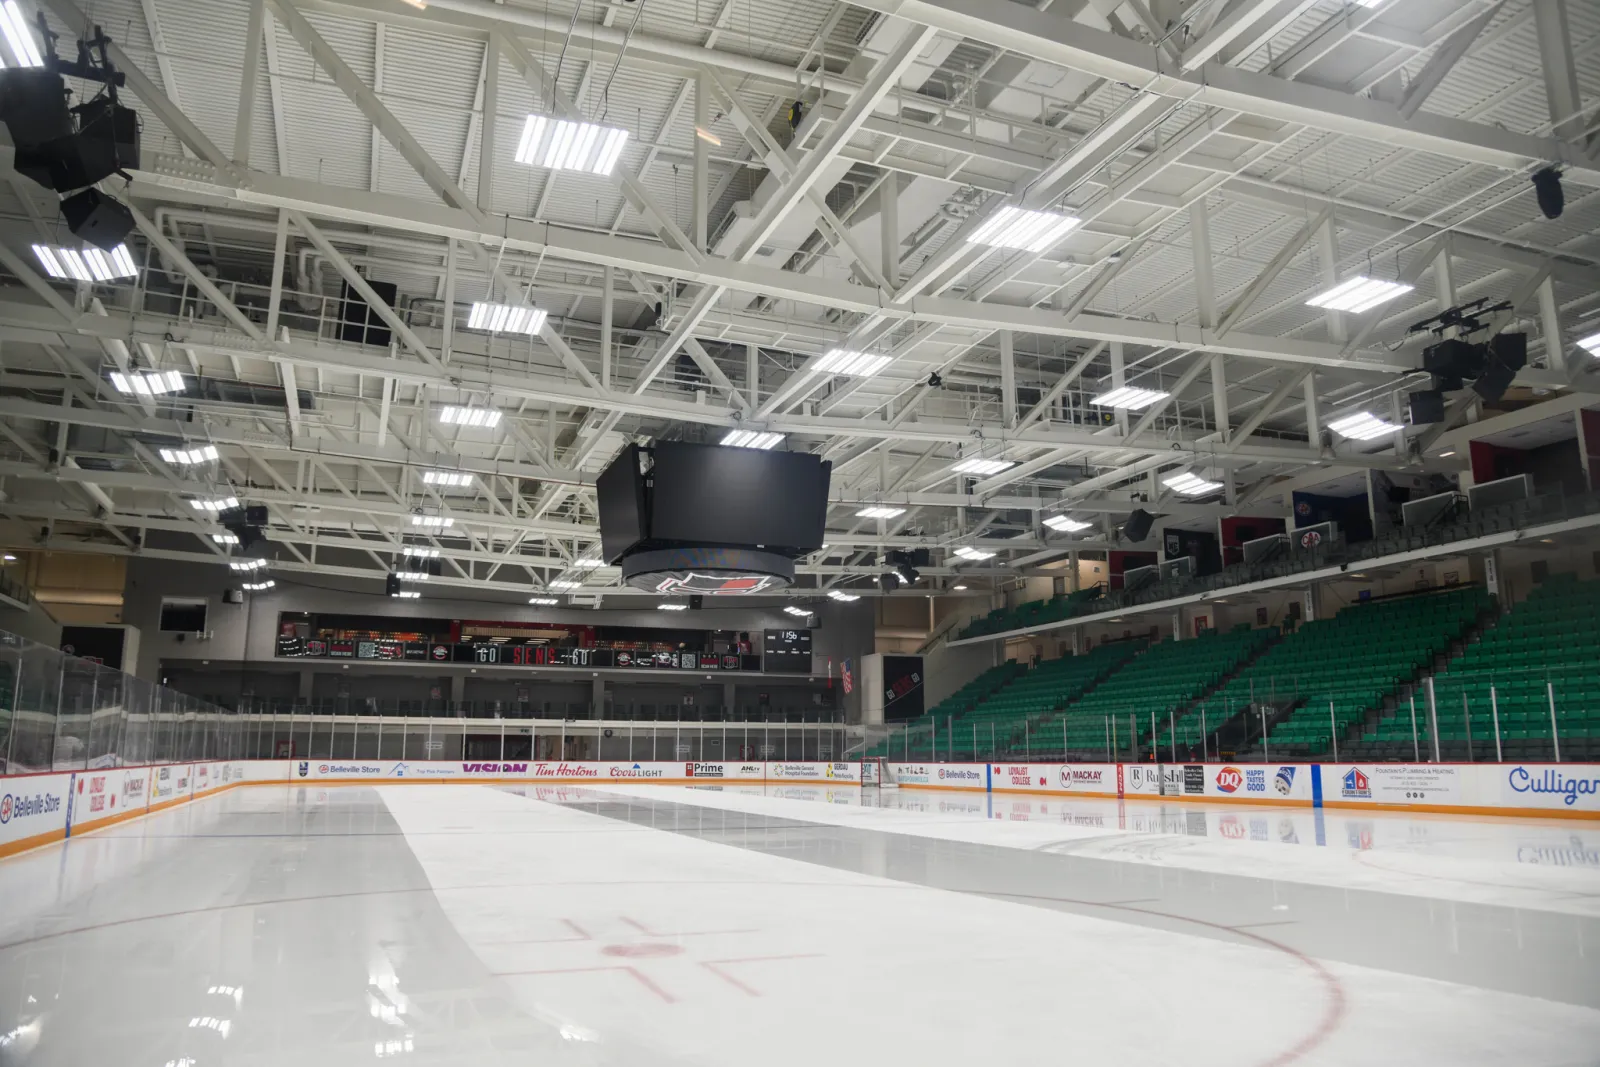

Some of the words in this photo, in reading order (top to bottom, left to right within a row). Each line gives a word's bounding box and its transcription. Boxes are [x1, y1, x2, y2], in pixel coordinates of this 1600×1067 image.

[513, 647, 556, 665] SENS
[463, 764, 528, 772] VISION
[535, 763, 555, 777] Tim
[556, 763, 598, 777] Hortons
[610, 767, 637, 777] Coors
[694, 763, 723, 773] Prime
[1008, 767, 1028, 775] LOYALIST
[946, 770, 966, 778] Belleville
[967, 771, 980, 779] Store
[1073, 771, 1102, 779] MACKAY
[1133, 769, 1140, 779] R
[1012, 776, 1031, 785] COLLEGE
[1220, 772, 1240, 788] DQ
[1247, 783, 1266, 791] GOOD
[13, 796, 43, 819] Belleville
[45, 793, 60, 813] Store
